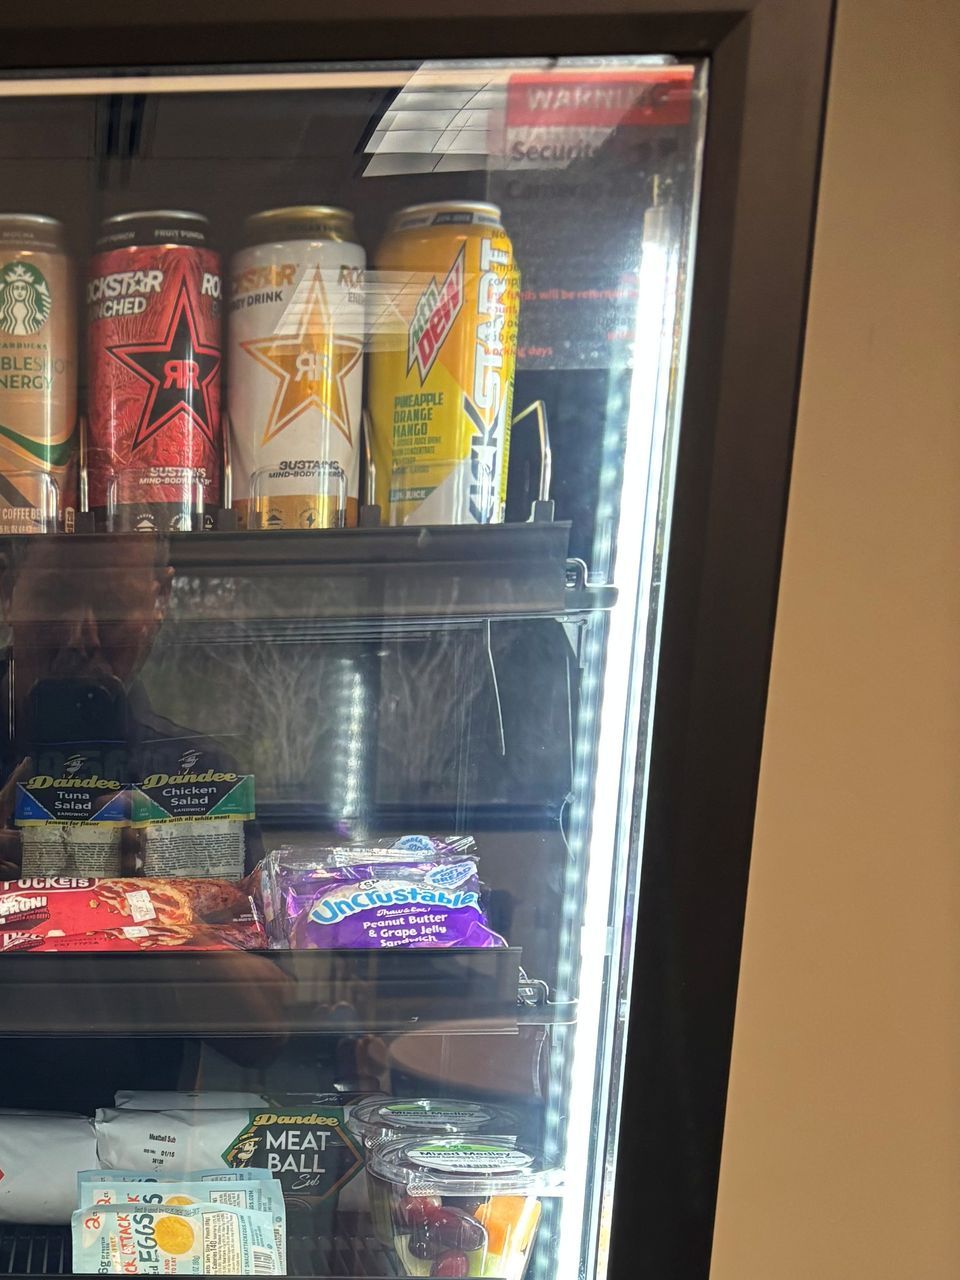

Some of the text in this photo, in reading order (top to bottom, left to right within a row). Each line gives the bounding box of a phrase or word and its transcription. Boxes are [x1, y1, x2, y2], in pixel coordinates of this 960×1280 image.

[247, 291, 283, 306] DRINK
[393, 392, 444, 408] PINEAPPLE
[393, 407, 433, 424] ORANGE
[393, 423, 428, 439] MANGO
[26, 774, 122, 790] Dandee
[141, 769, 238, 790] Dandee
[56, 791, 90, 800] Tuna
[162, 786, 217, 797] Chicken
[54, 801, 92, 810] Salad
[170, 796, 209, 806] Salad
[363, 913, 448, 930] Peanut Butter
[368, 925, 447, 941] & Grape Jelly
[253, 1113, 340, 1127] Dandee
[265, 1130, 331, 1151] MEAT
[266, 1153, 326, 1174] BALL
[291, 1173, 320, 1191] Sub
[133, 1213, 159, 1263] EGGS
